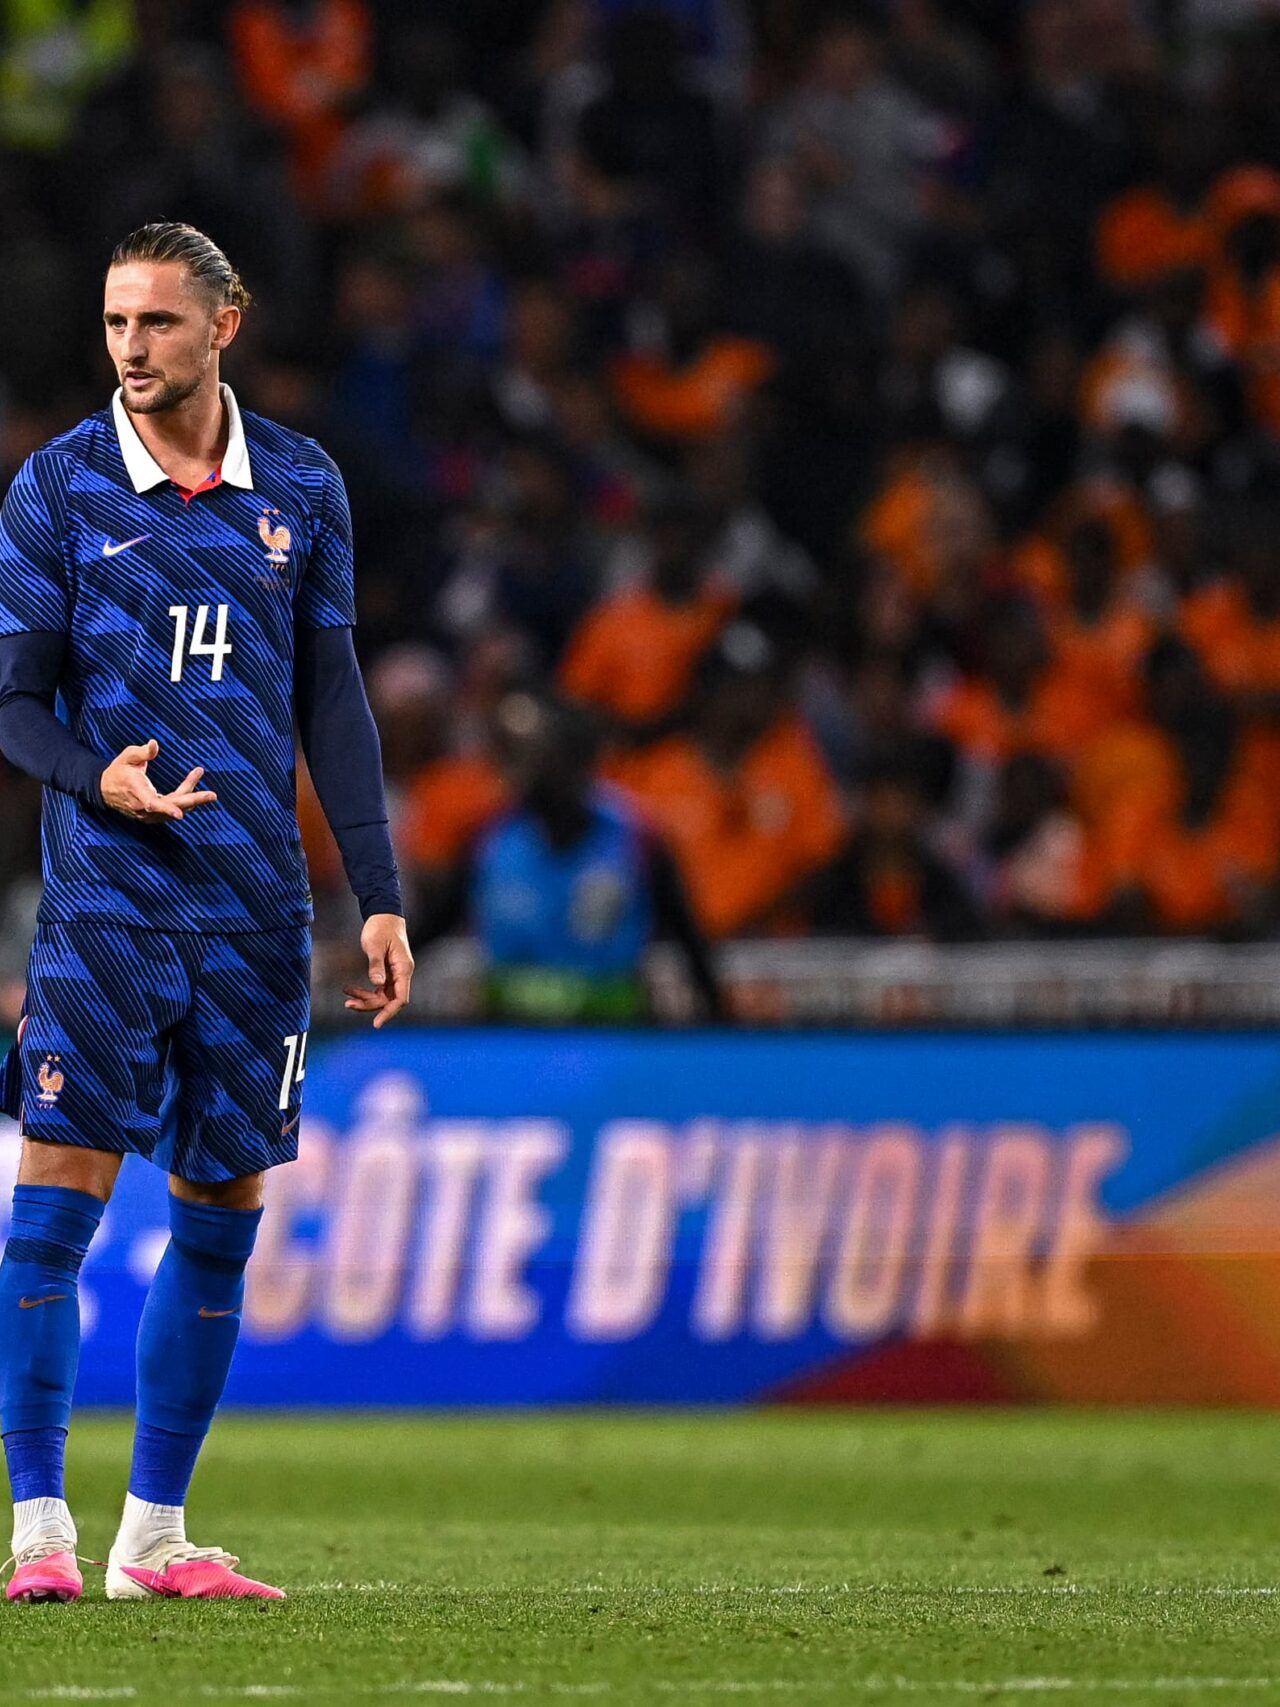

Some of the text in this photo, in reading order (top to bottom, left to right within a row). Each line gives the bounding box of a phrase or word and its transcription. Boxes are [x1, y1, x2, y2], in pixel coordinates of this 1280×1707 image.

[168, 604, 232, 682] 14
[244, 1072, 568, 1338] CÔTE
[567, 1120, 1126, 1340] D'IVOIRE
